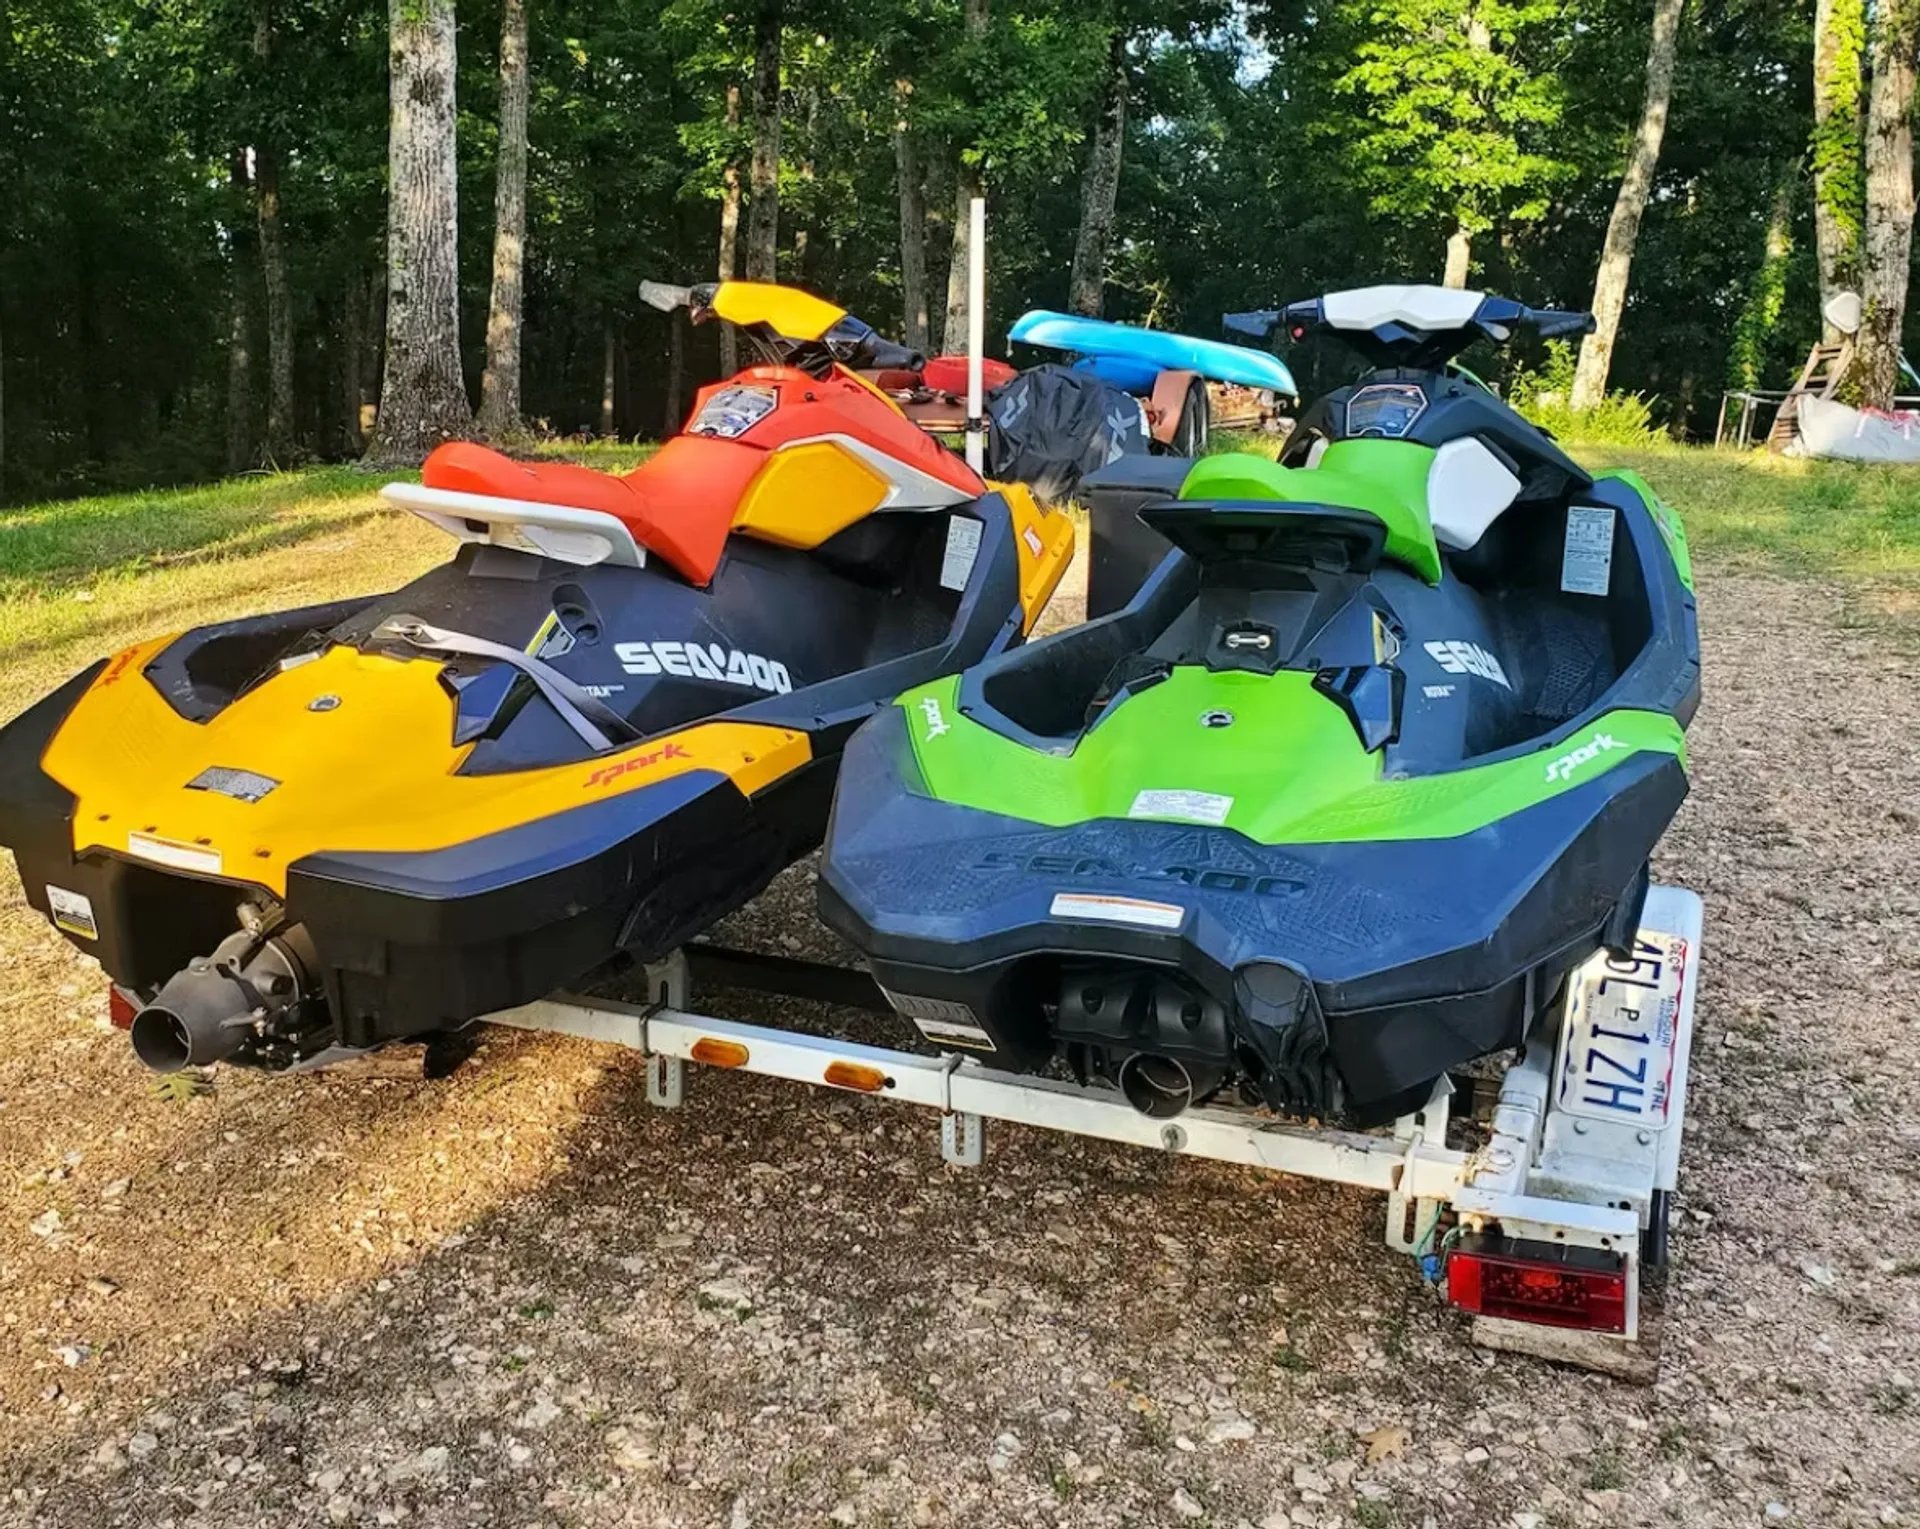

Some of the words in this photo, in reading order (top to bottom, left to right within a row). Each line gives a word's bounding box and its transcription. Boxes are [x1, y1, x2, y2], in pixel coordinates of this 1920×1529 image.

[918, 697, 951, 743] spark
[583, 743, 693, 788] spark
[1545, 732, 1629, 783] spark
[1620, 1006, 1640, 1022] P
[1661, 995, 1677, 1048] MISSOURI
[1583, 1023, 1650, 1114] 1ZH
